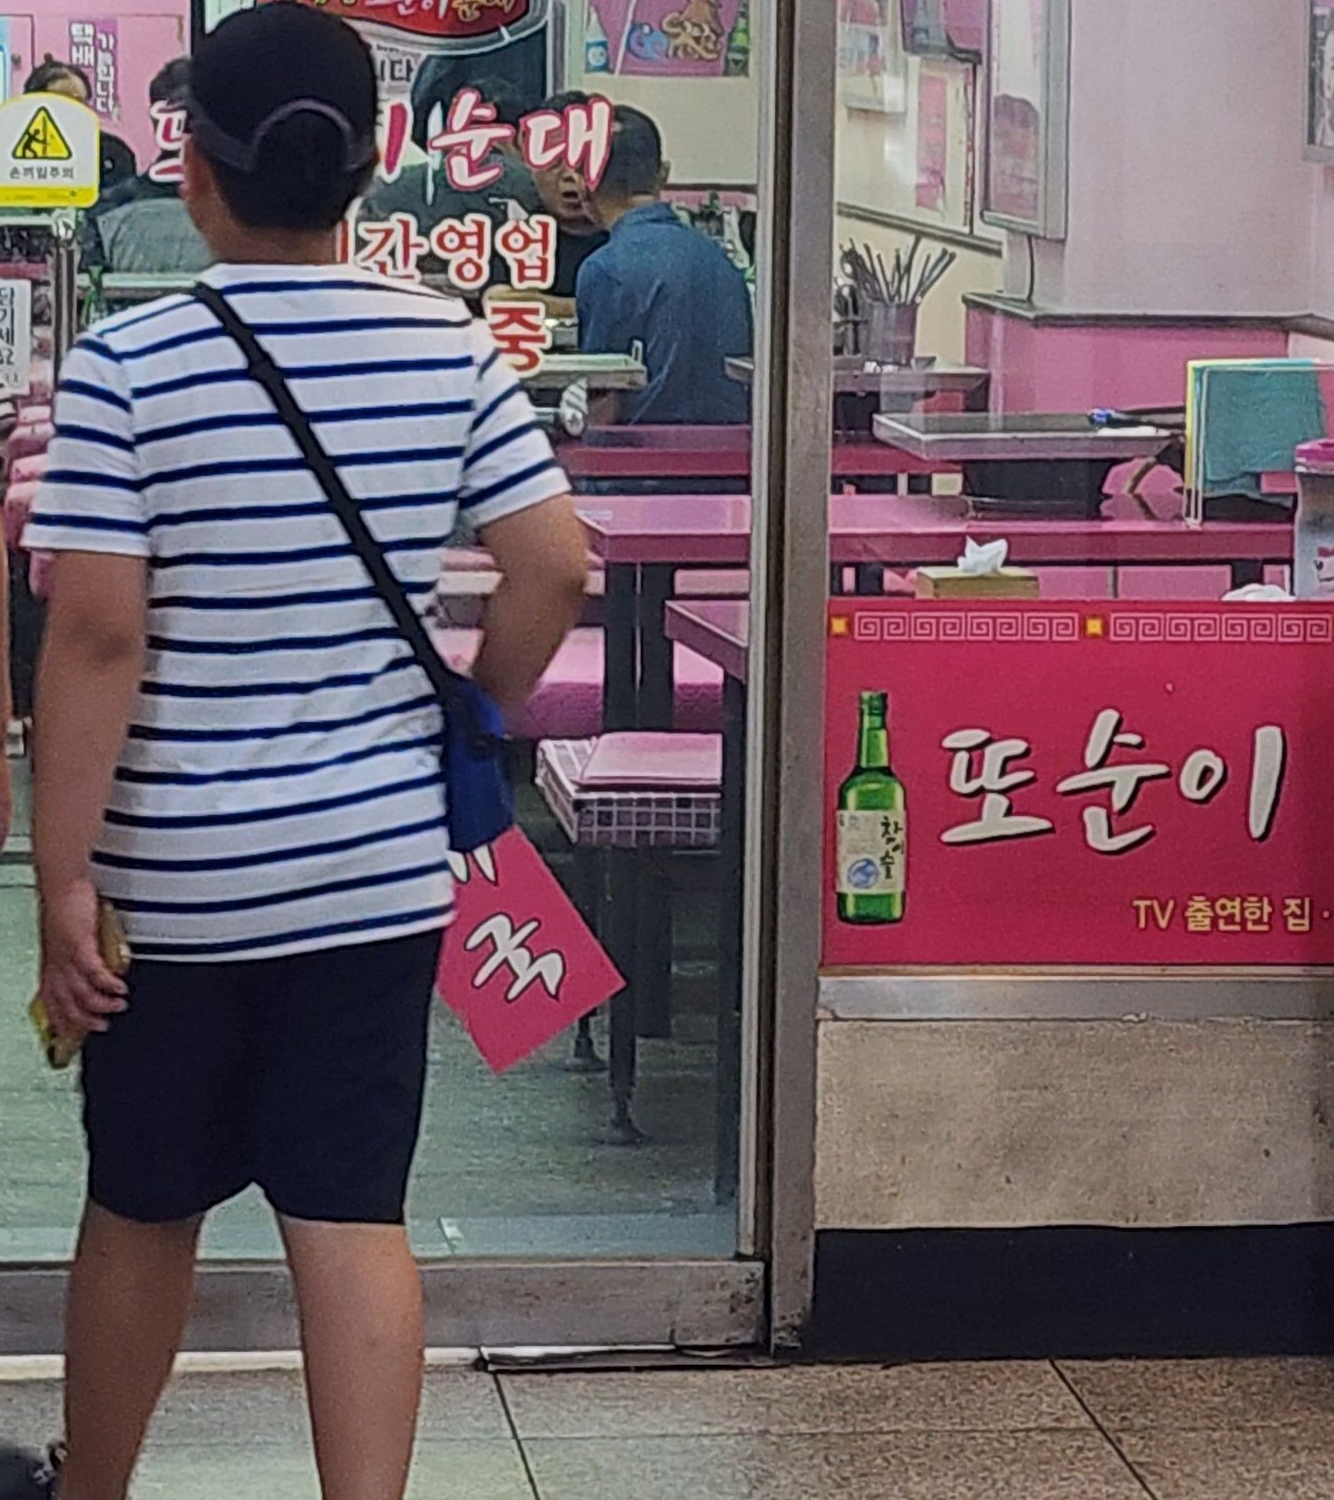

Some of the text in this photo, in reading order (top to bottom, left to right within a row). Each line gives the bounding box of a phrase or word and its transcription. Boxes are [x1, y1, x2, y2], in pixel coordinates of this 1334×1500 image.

[940, 708, 1284, 852] 또순이
[1133, 900, 1174, 929] TV
[1184, 898, 1273, 932] 출연한
[1282, 899, 1312, 932] 집
